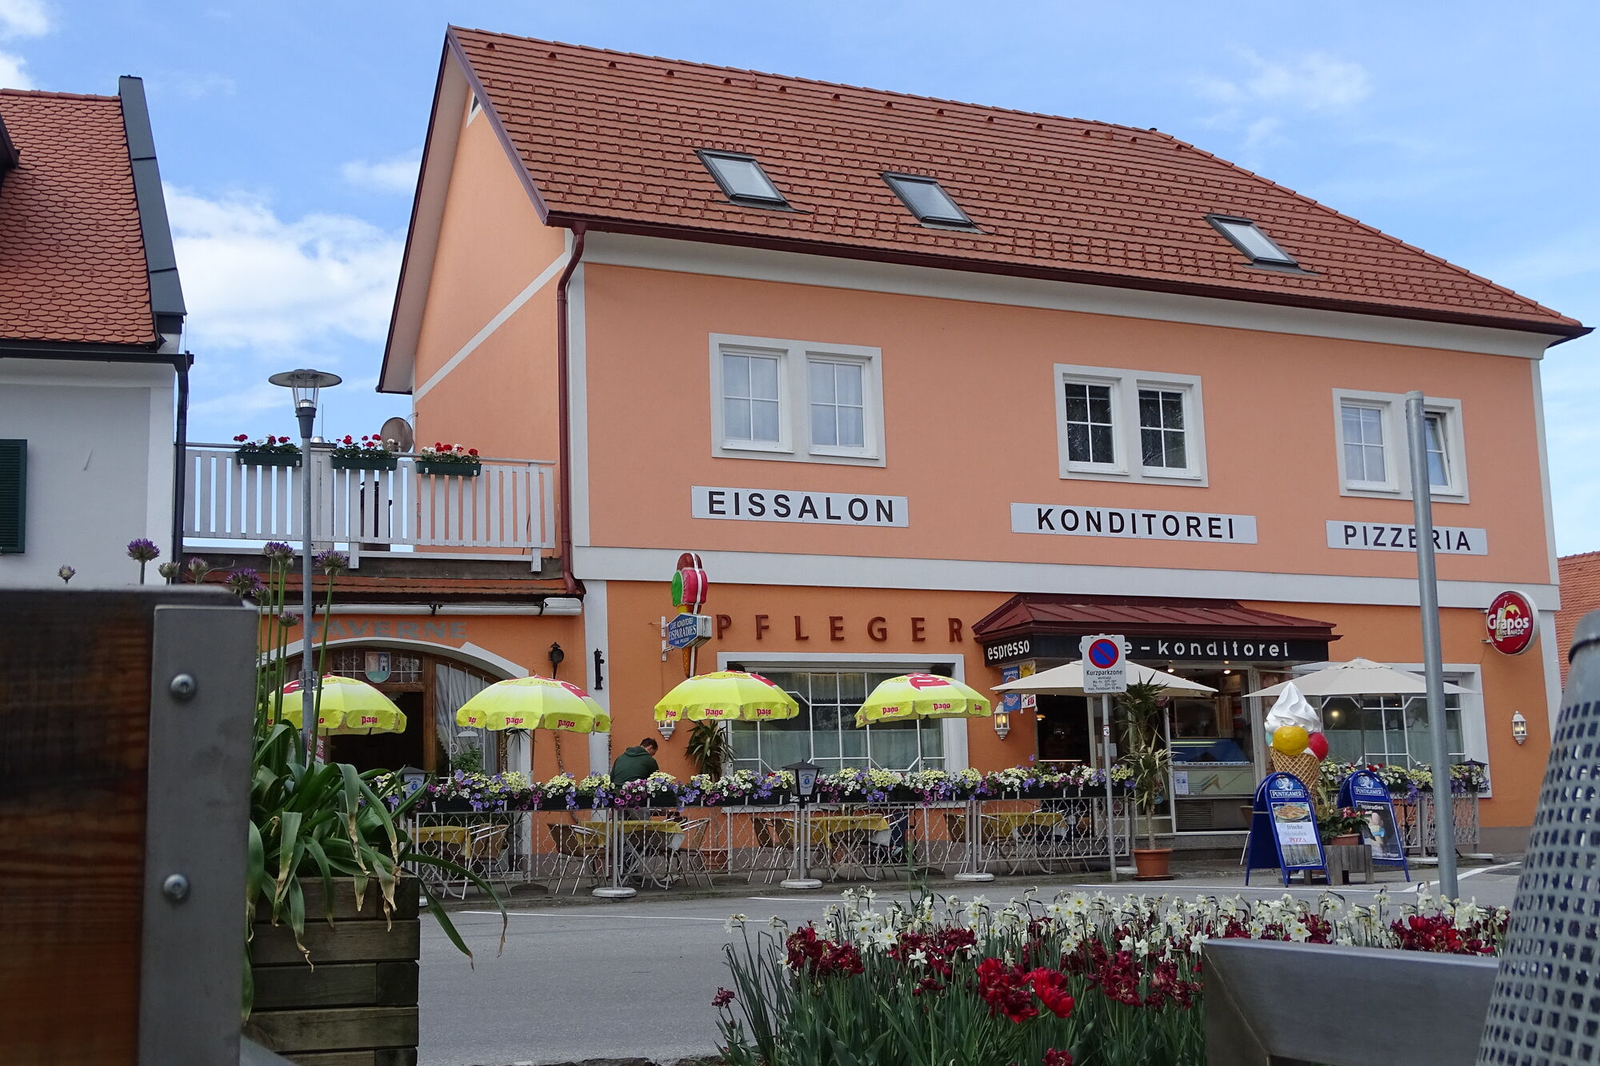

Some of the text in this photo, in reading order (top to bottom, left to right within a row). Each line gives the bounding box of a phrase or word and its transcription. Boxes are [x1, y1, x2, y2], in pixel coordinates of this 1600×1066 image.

[708, 490, 893, 522] EISSALON
[1037, 507, 1234, 539] KONDITOREI
[1344, 525, 1471, 551] PIZZERIA
[311, 620, 468, 639] TAVERNE
[716, 614, 963, 642] PFLEGER
[987, 639, 1030, 660] espresso
[1158, 640, 1290, 657] konditorei
[704, 708, 724, 717] pago
[756, 708, 772, 717] pago
[882, 706, 899, 715] pago
[360, 716, 378, 725] pago
[505, 717, 524, 725] pago
[557, 719, 576, 728] pago
